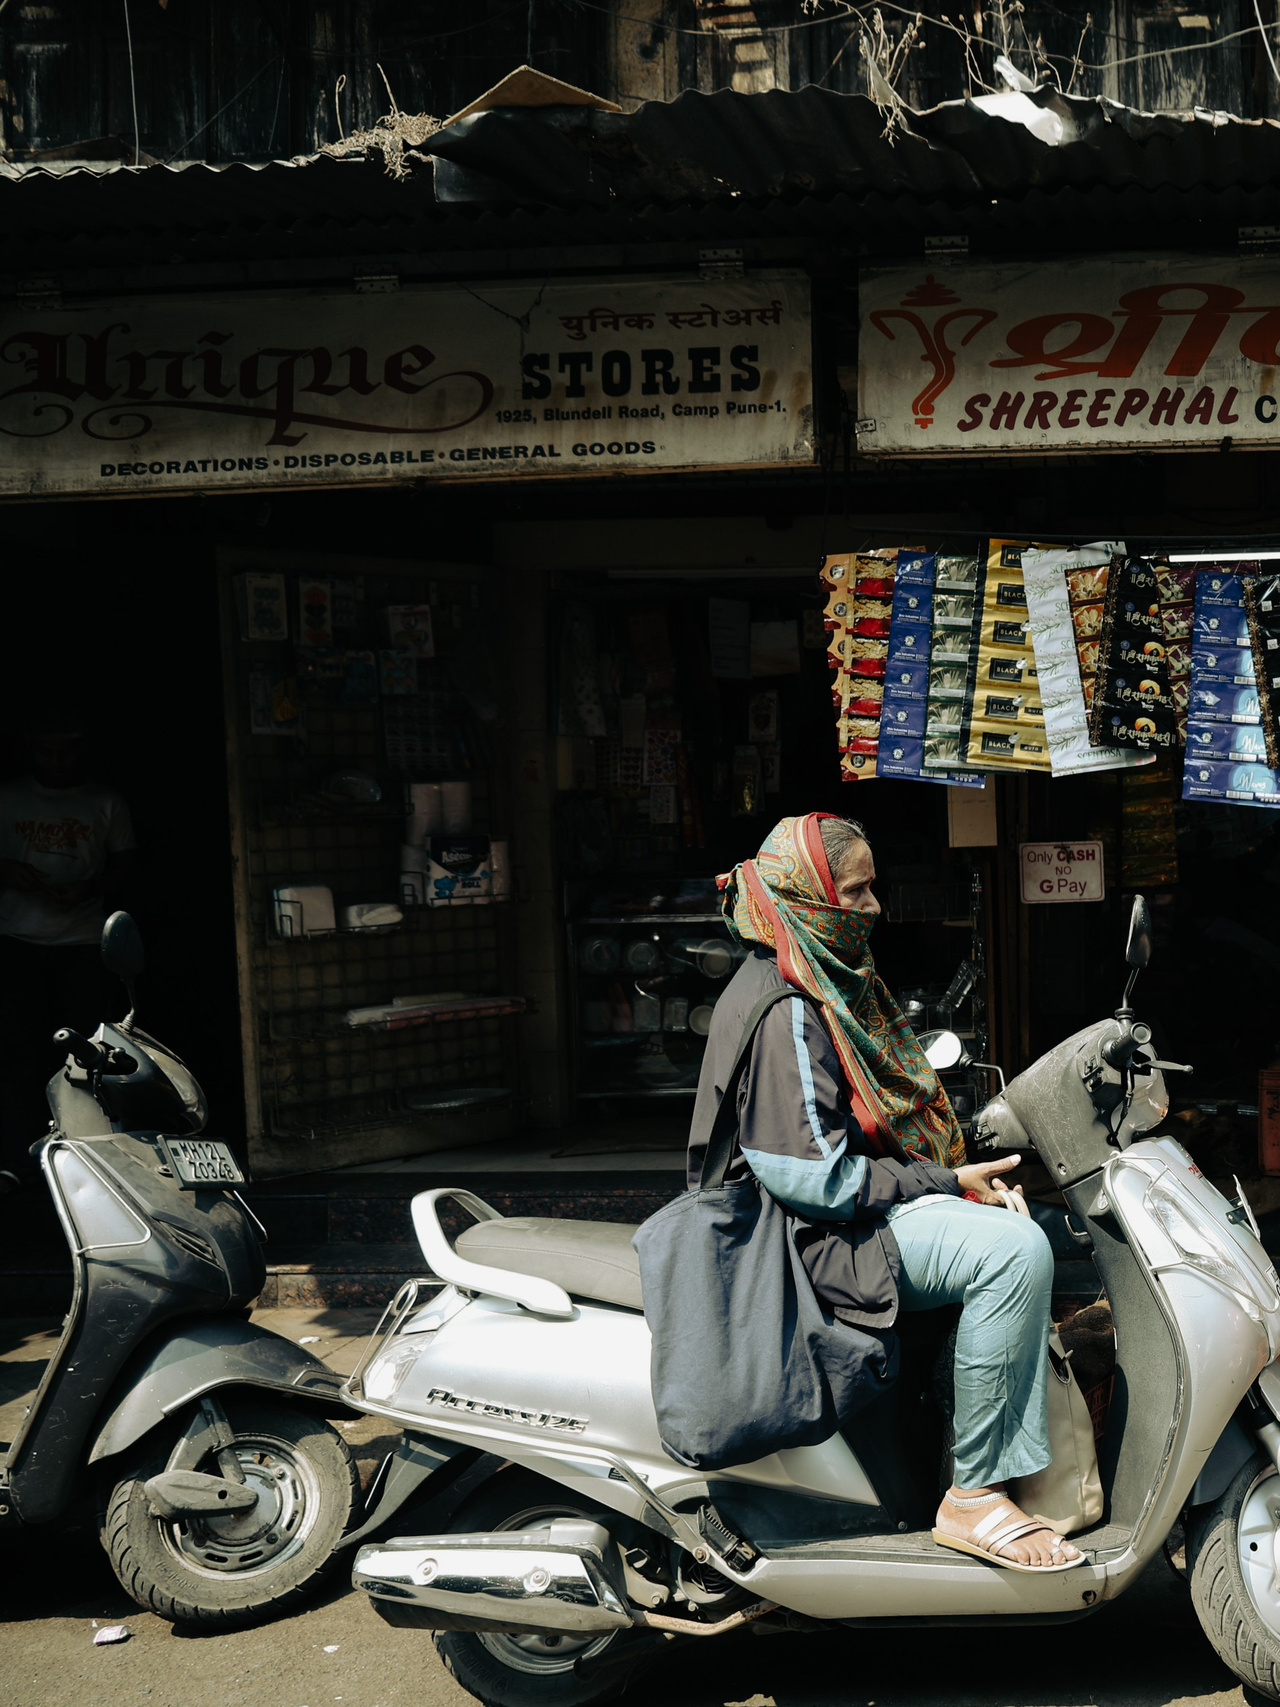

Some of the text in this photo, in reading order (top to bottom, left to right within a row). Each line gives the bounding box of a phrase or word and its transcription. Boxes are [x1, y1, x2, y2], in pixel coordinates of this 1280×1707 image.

[558, 300, 783, 341] युनिक स्टोअर्स
[522, 344, 761, 400] STORES
[0, 322, 494, 446] Unique
[495, 400, 787, 425] 1925, Blundell Road, Camp Pune-1.
[957, 386, 1239, 432] SHREEPHAL
[100, 441, 656, 478] DECORATIONS DISPOSABLE GENERAL GOODS
[1007, 553, 1021, 561] BLA
[1000, 628, 1023, 637] BLACK
[996, 666, 1019, 675] BLACK
[992, 703, 1016, 712] BLACK
[988, 740, 1011, 749] BLACK
[1077, 748, 1122, 761] SCENTOSA
[1027, 849, 1096, 864] Only CASH
[1055, 866, 1072, 875] NO
[1040, 878, 1087, 896] G Pay
